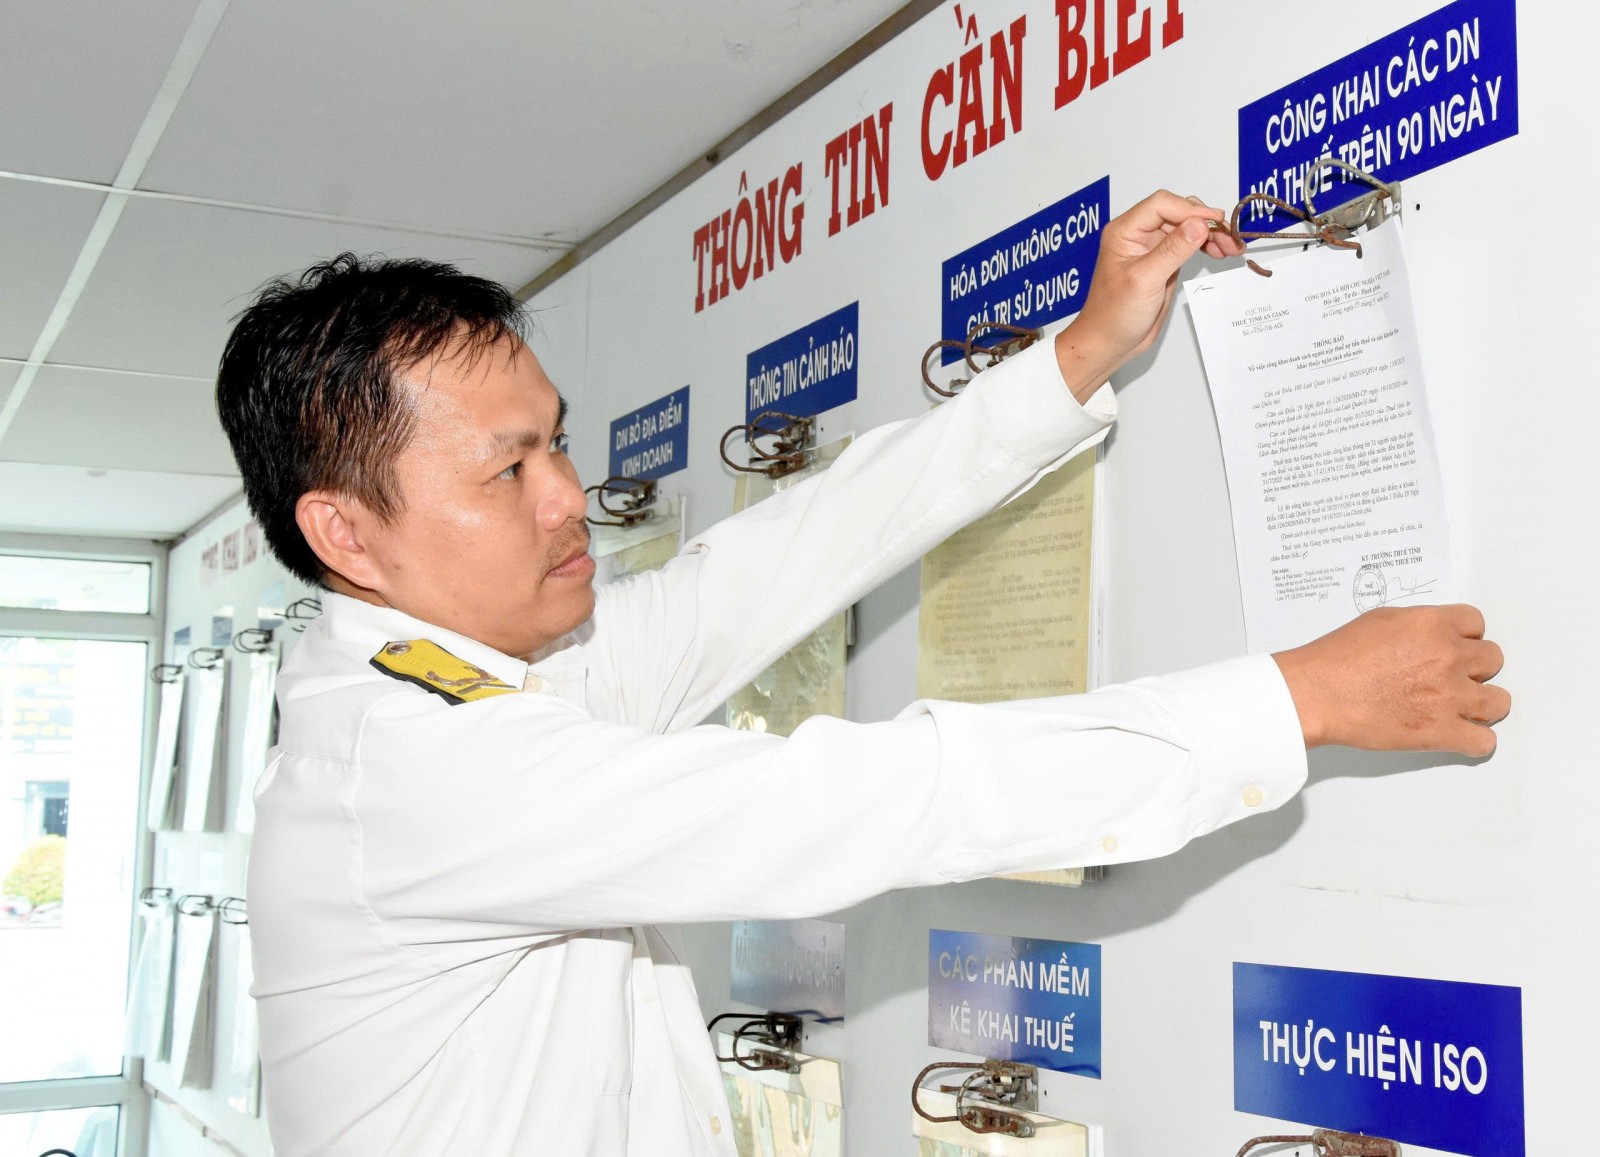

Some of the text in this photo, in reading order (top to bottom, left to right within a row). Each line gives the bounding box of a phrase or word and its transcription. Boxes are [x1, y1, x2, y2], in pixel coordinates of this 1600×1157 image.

[1266, 17, 1479, 153] CÔNG KHAI CÁC DN
[694, 162, 804, 314] THÔNG
[825, 101, 893, 238] TIN
[920, 3, 1027, 181] CẦN
[1250, 74, 1502, 222] NỢ THUẾ TRÊN 90 NGÀY
[951, 203, 1099, 301] HÓA ĐƠN KHÔNG CÒN
[967, 302, 990, 340] GIÁ
[1014, 279, 1032, 320] SỬ
[1036, 268, 1079, 311] DỤNG
[750, 326, 854, 411] THÔNG TIN CẢNH BÁO
[616, 396, 682, 450] DN BỎ ĐỊA ĐIỂM
[622, 441, 673, 478] KINH DOANH
[939, 946, 1090, 997] CÁC PHẦN MỀM
[950, 1000, 1075, 1053] KÊ KHAI THUẾ
[1259, 1019, 1488, 1095] THỰC HIỆN ISO
